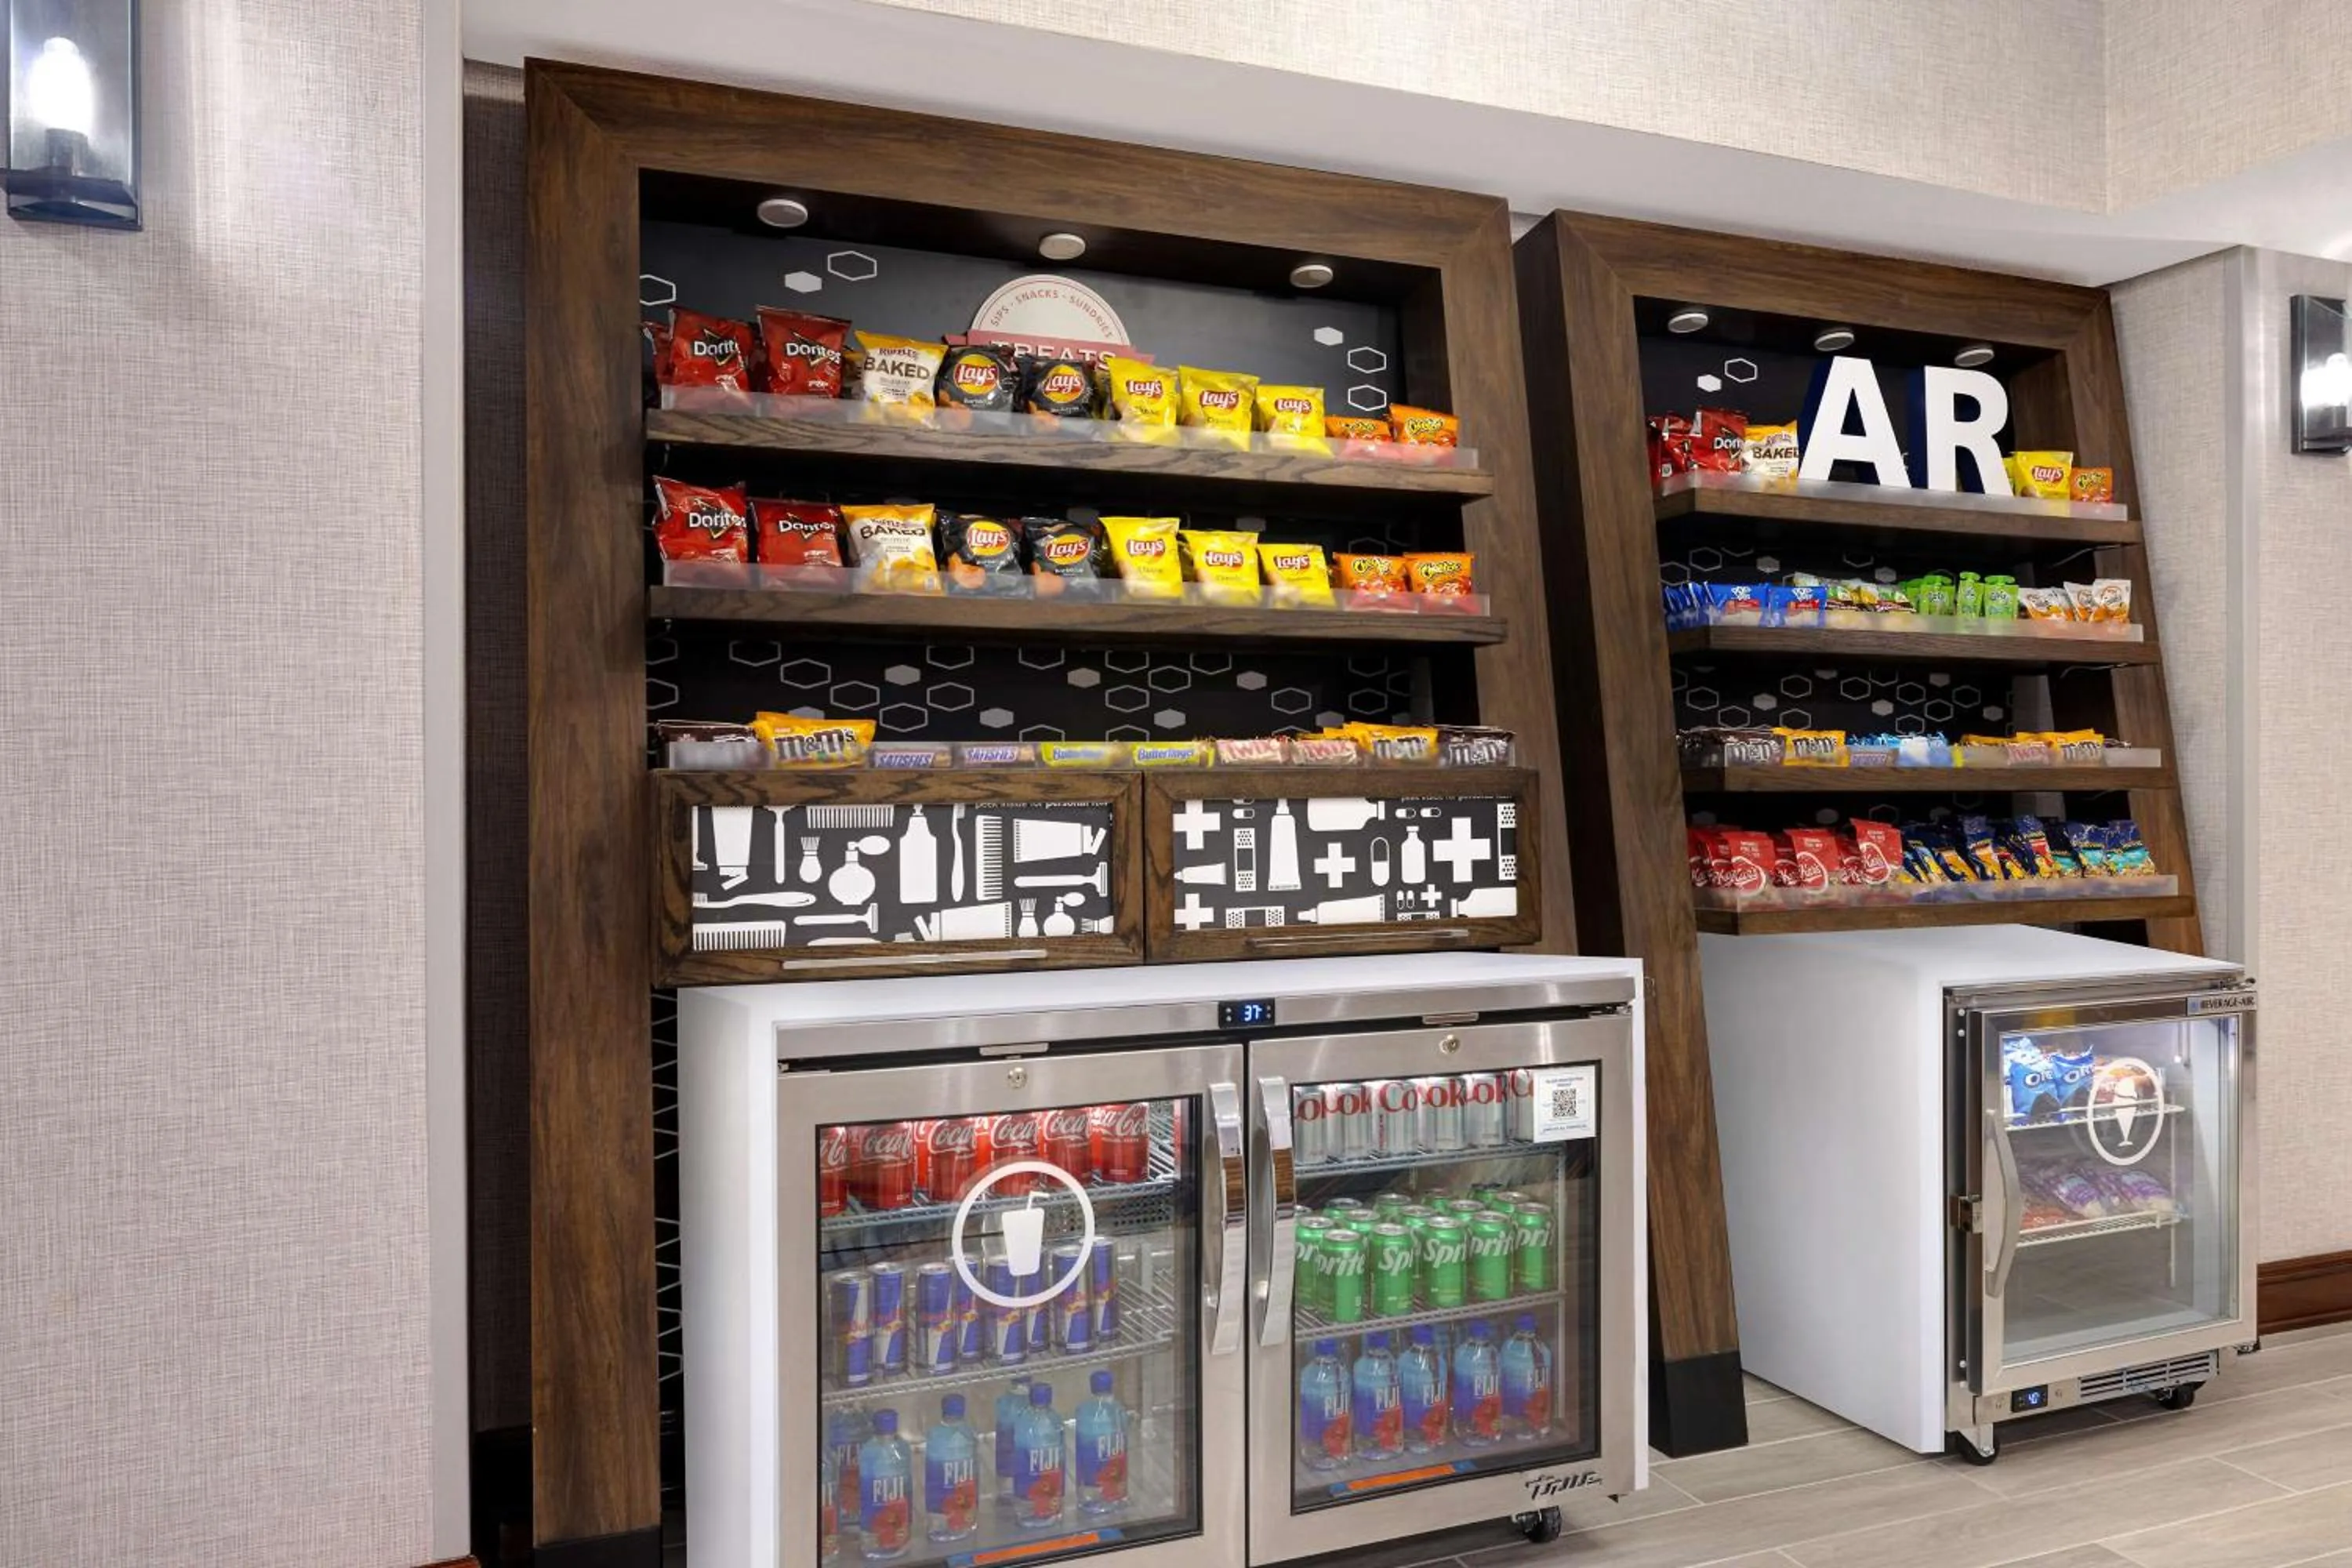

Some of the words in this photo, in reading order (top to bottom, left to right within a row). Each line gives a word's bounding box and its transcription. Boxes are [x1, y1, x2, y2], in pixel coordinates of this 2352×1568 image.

[1015, 289, 1059, 303] SNACKS
[1069, 296, 1114, 339] SUNDRIES
[864, 357, 931, 380] BAKED
[958, 363, 997, 386] Lay's
[1129, 379, 1161, 398] Lay's
[1201, 390, 1238, 408] Lay's
[1277, 398, 1311, 414] Lay's
[969, 528, 1008, 549] Lay's
[1047, 539, 1087, 559] Lay's
[1129, 539, 1164, 557] Lay's
[1423, 1380, 1445, 1406] FIJI
[1474, 1374, 1499, 1397] FIJI
[1375, 1385, 1400, 1411] FIJI
[1098, 1432, 1126, 1460] FIJI
[1029, 1446, 1061, 1472] FIJI
[944, 1458, 974, 1486] FIJI
[873, 1476, 905, 1503] FIJI
